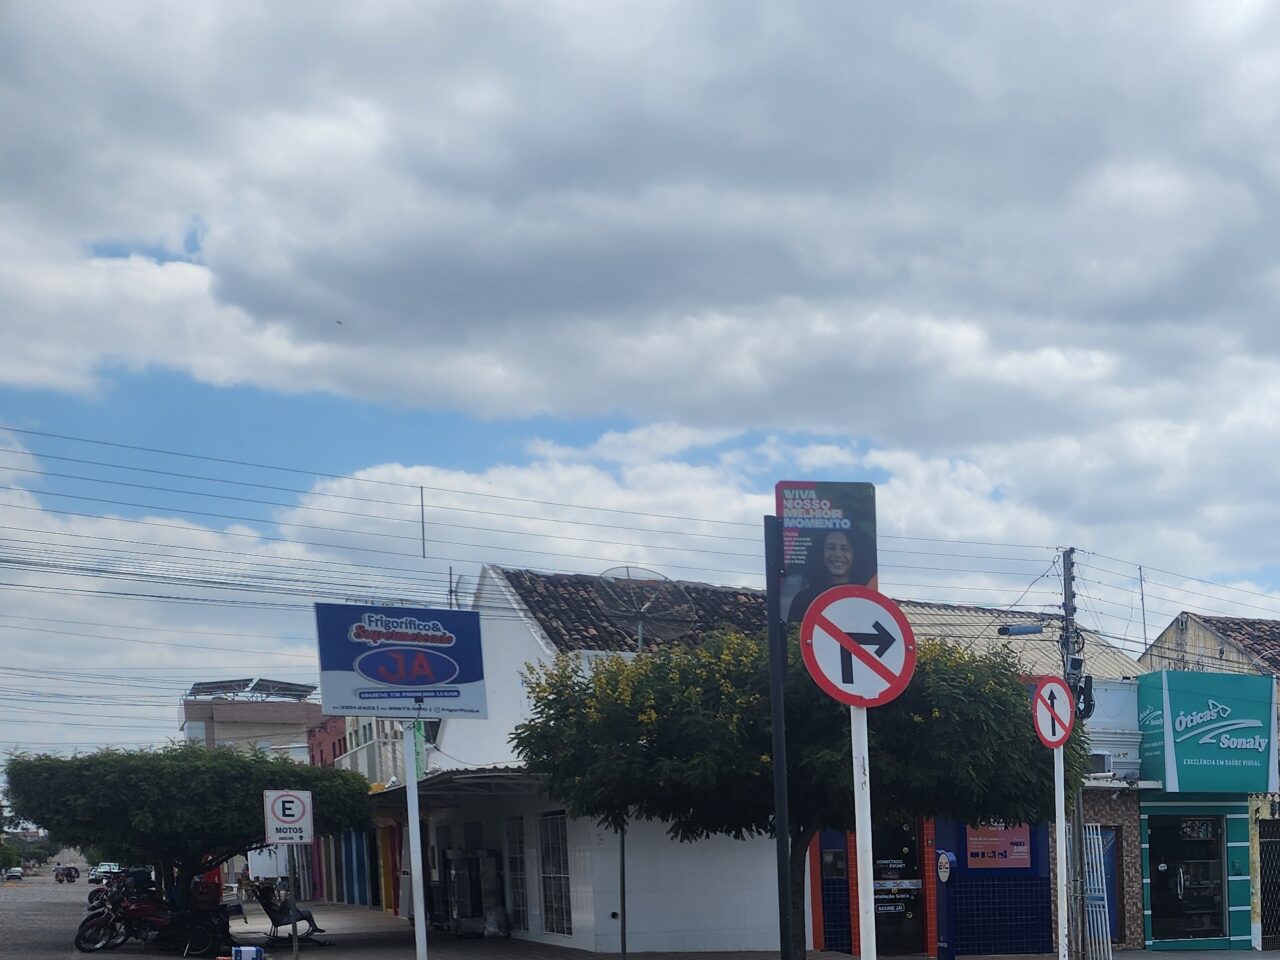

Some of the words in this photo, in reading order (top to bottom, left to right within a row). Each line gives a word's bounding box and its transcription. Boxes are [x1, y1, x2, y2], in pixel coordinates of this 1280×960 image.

[783, 490, 817, 499] VIVA
[783, 499, 830, 509] NOSSO
[783, 509, 843, 518] MELHOR
[783, 518, 851, 529] MOMENTO
[377, 651, 436, 682] JA
[1175, 706, 1217, 732] Óticas
[1219, 732, 1269, 752] Sonaly
[281, 800, 295, 817] E
